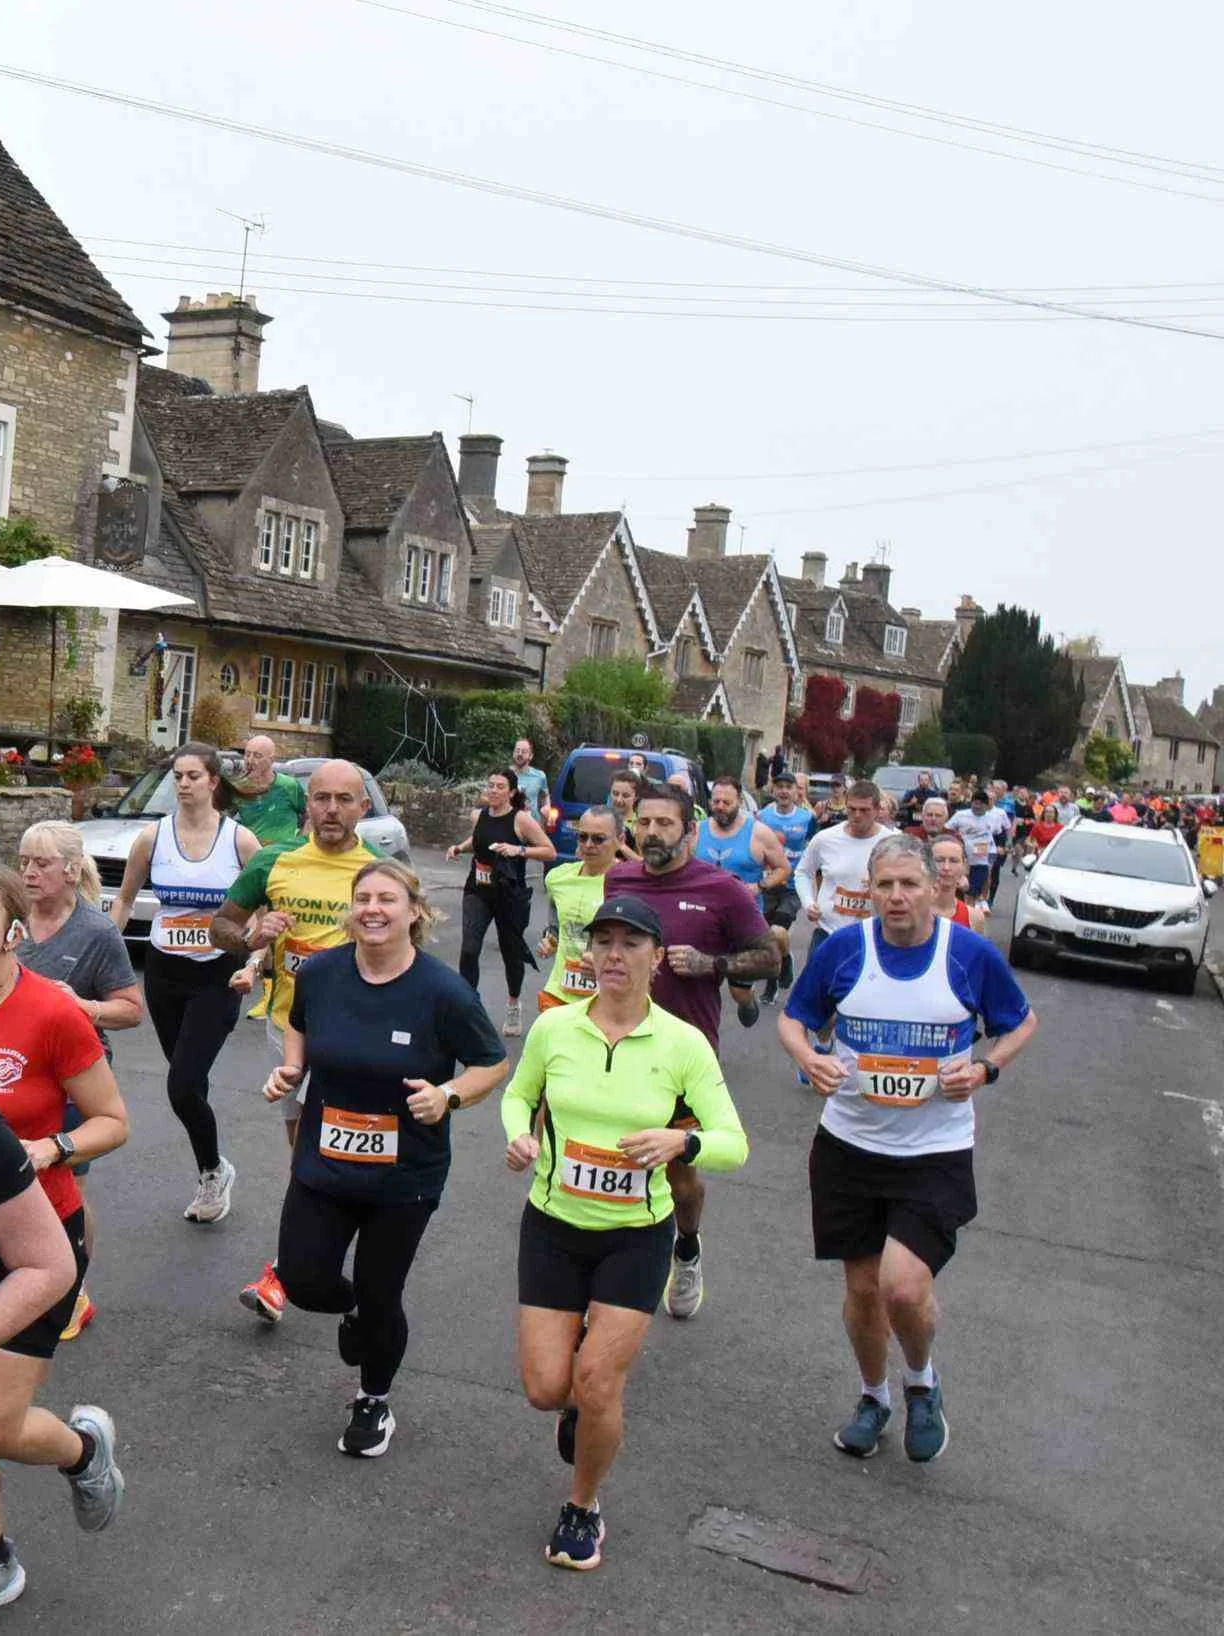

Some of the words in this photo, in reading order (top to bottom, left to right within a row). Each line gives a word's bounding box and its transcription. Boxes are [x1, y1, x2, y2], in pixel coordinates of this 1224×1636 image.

[158, 890, 225, 903] IPPENHAM
[279, 896, 323, 910] AVON
[327, 899, 351, 911] VA
[840, 896, 866, 909] 1122
[292, 912, 338, 926] RUNN
[167, 929, 207, 946] 1046
[846, 1018, 950, 1048] CHIPPENHAM
[869, 1074, 926, 1097] 1097
[329, 1129, 385, 1155] 2728
[571, 1164, 633, 1195] 1184
